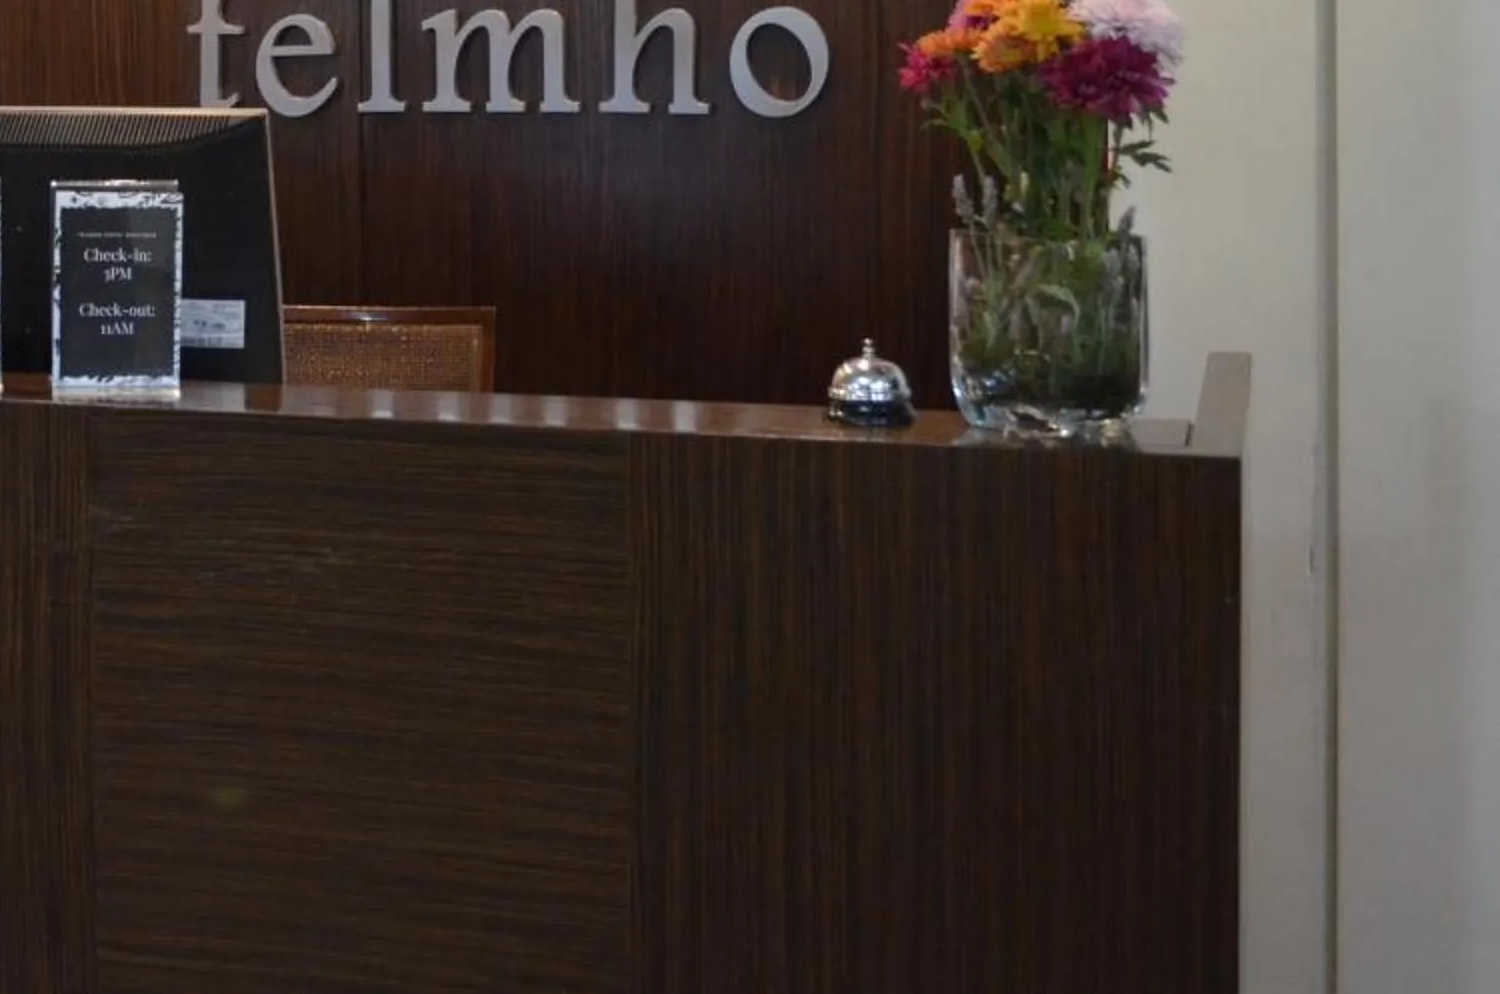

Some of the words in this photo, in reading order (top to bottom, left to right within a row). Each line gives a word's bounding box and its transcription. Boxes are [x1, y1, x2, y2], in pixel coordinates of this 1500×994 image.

[83, 247, 152, 262] Check-in:
[104, 267, 132, 282] 3PM
[79, 302, 155, 318] Check-out:
[100, 321, 135, 335] 11AM
